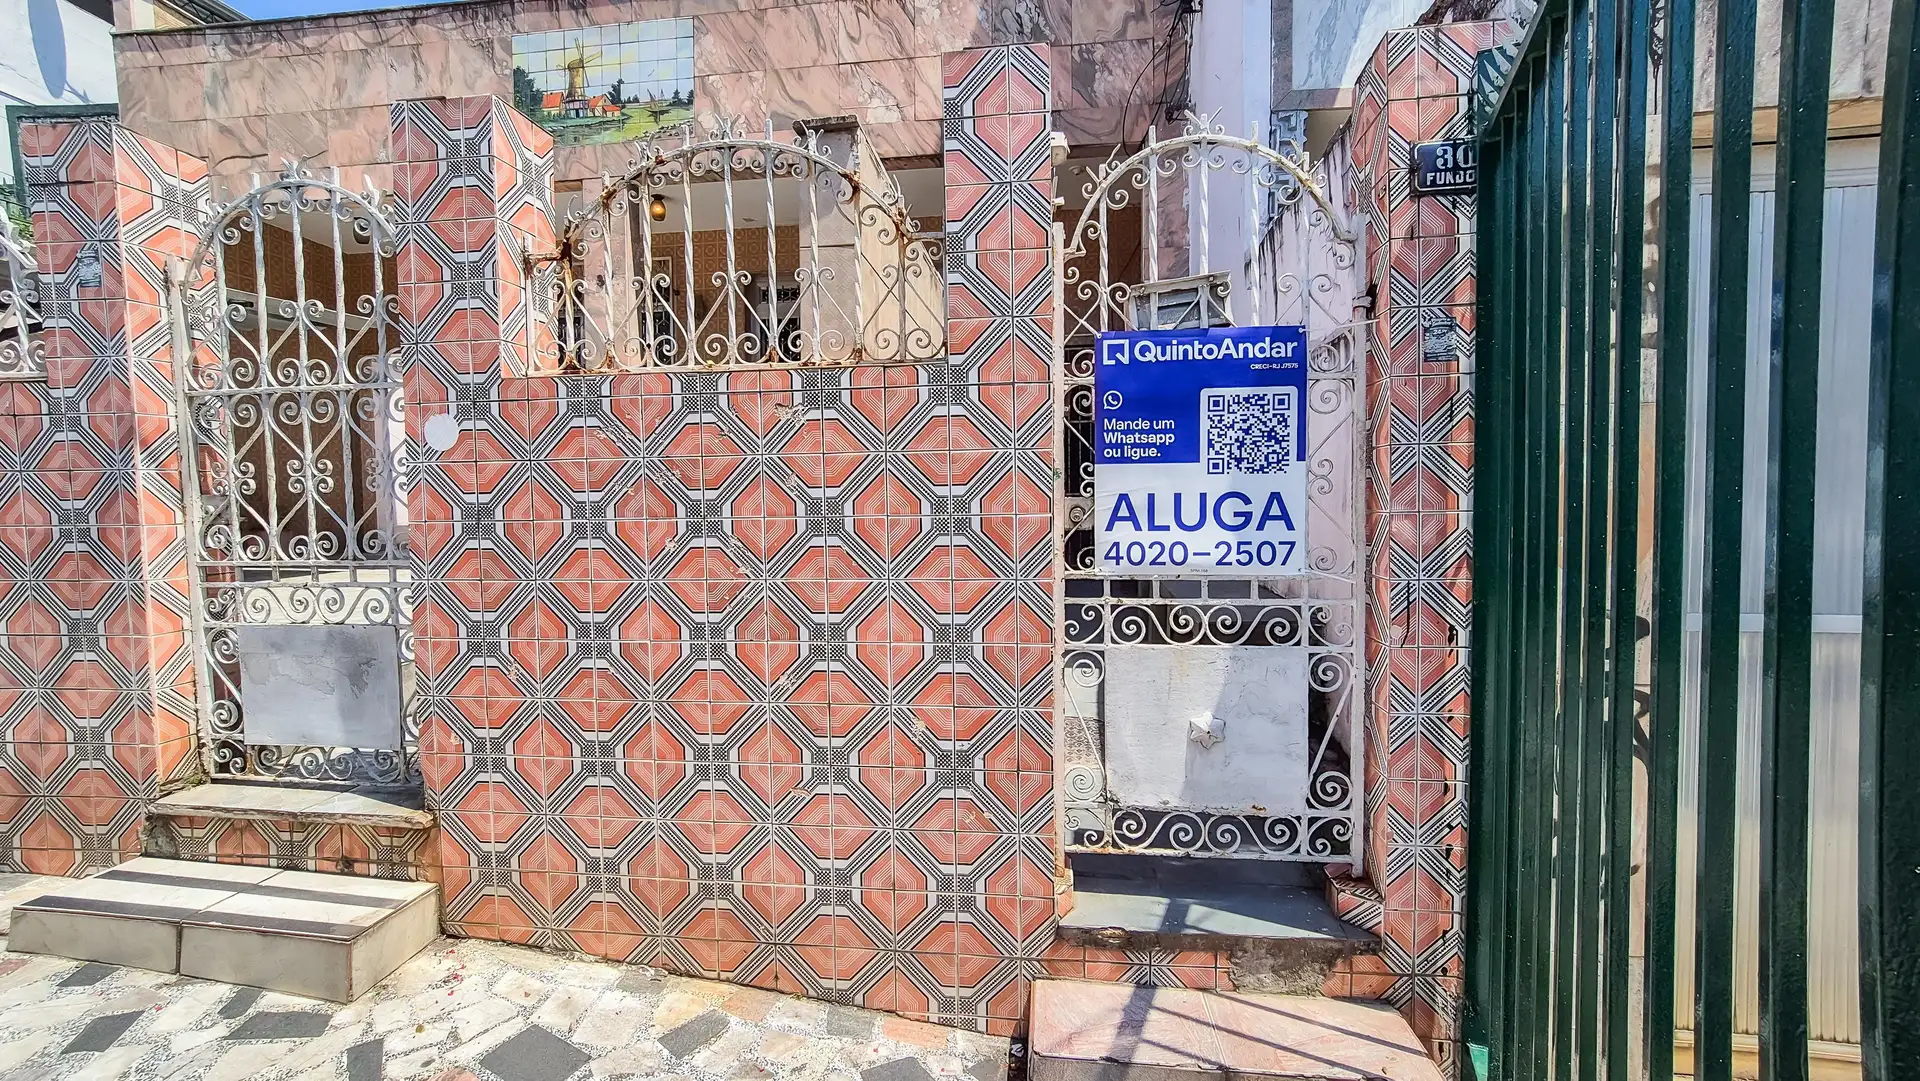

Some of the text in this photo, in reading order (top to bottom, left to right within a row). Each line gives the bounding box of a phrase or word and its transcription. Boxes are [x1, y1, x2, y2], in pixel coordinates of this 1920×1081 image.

[1134, 337, 1298, 363] QuintoAndar
[1103, 418, 1175, 430] Mande um
[1103, 431, 1175, 445] Whatsapp
[1103, 445, 1162, 461] ou ligue.
[1104, 491, 1296, 532] ALUGA
[1103, 540, 1297, 567] 4020-2507
